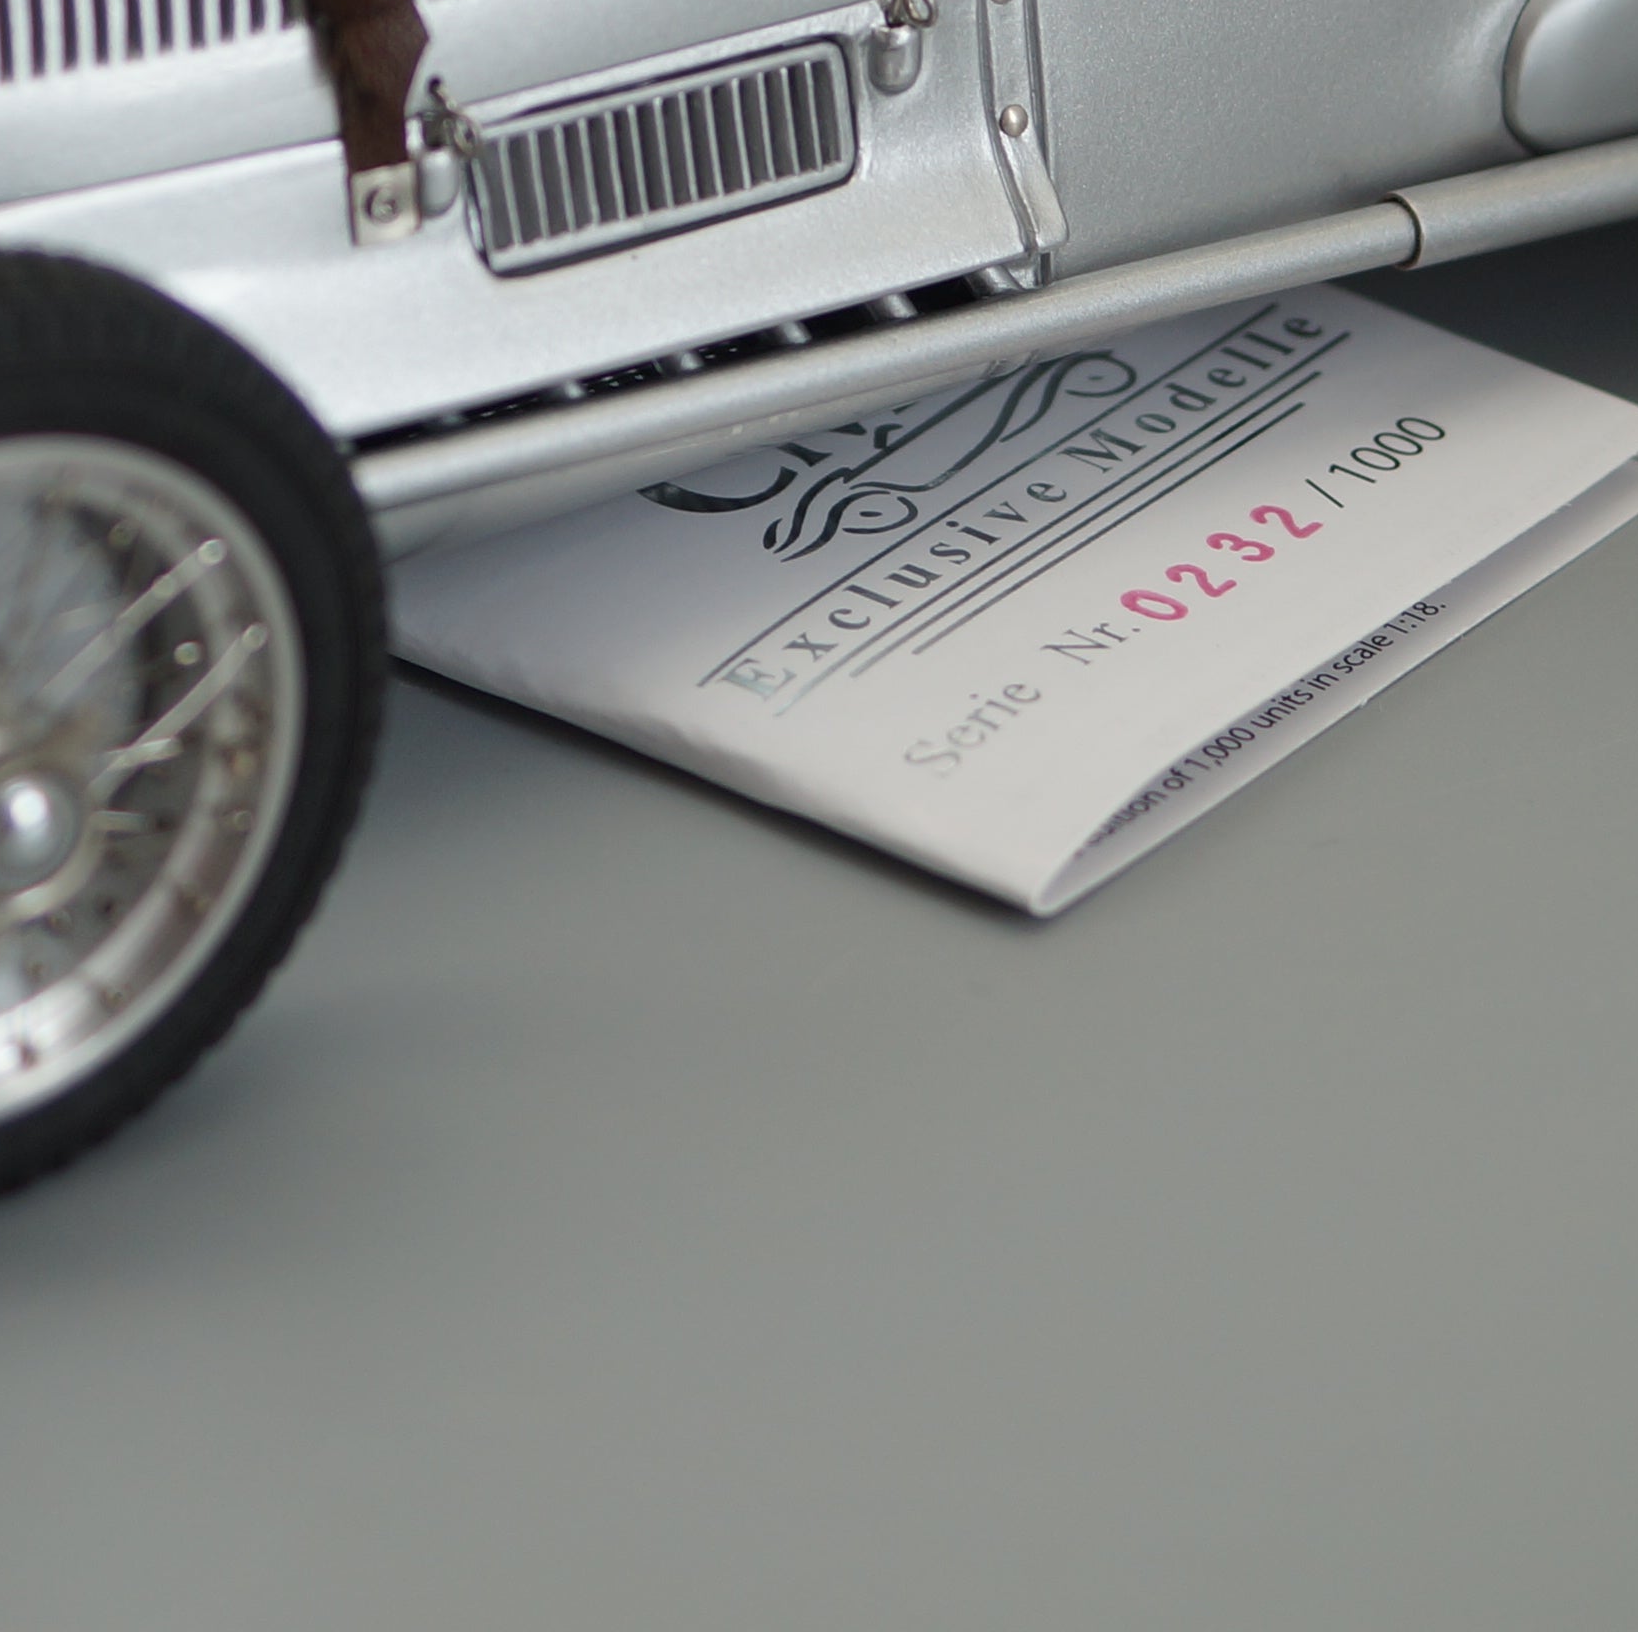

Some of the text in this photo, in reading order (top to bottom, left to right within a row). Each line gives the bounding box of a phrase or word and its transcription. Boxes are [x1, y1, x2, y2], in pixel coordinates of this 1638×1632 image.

[716, 479, 1067, 702] Exclusive
[1056, 317, 1323, 474] Modelle
[903, 683, 1042, 780] Serie
[1120, 504, 1323, 621] 0232
[1162, 766, 1195, 791] of
[1184, 727, 1256, 770] 1,000
[1249, 686, 1315, 730] units
[1301, 670, 1340, 692] in
[1332, 633, 1394, 675] scale
